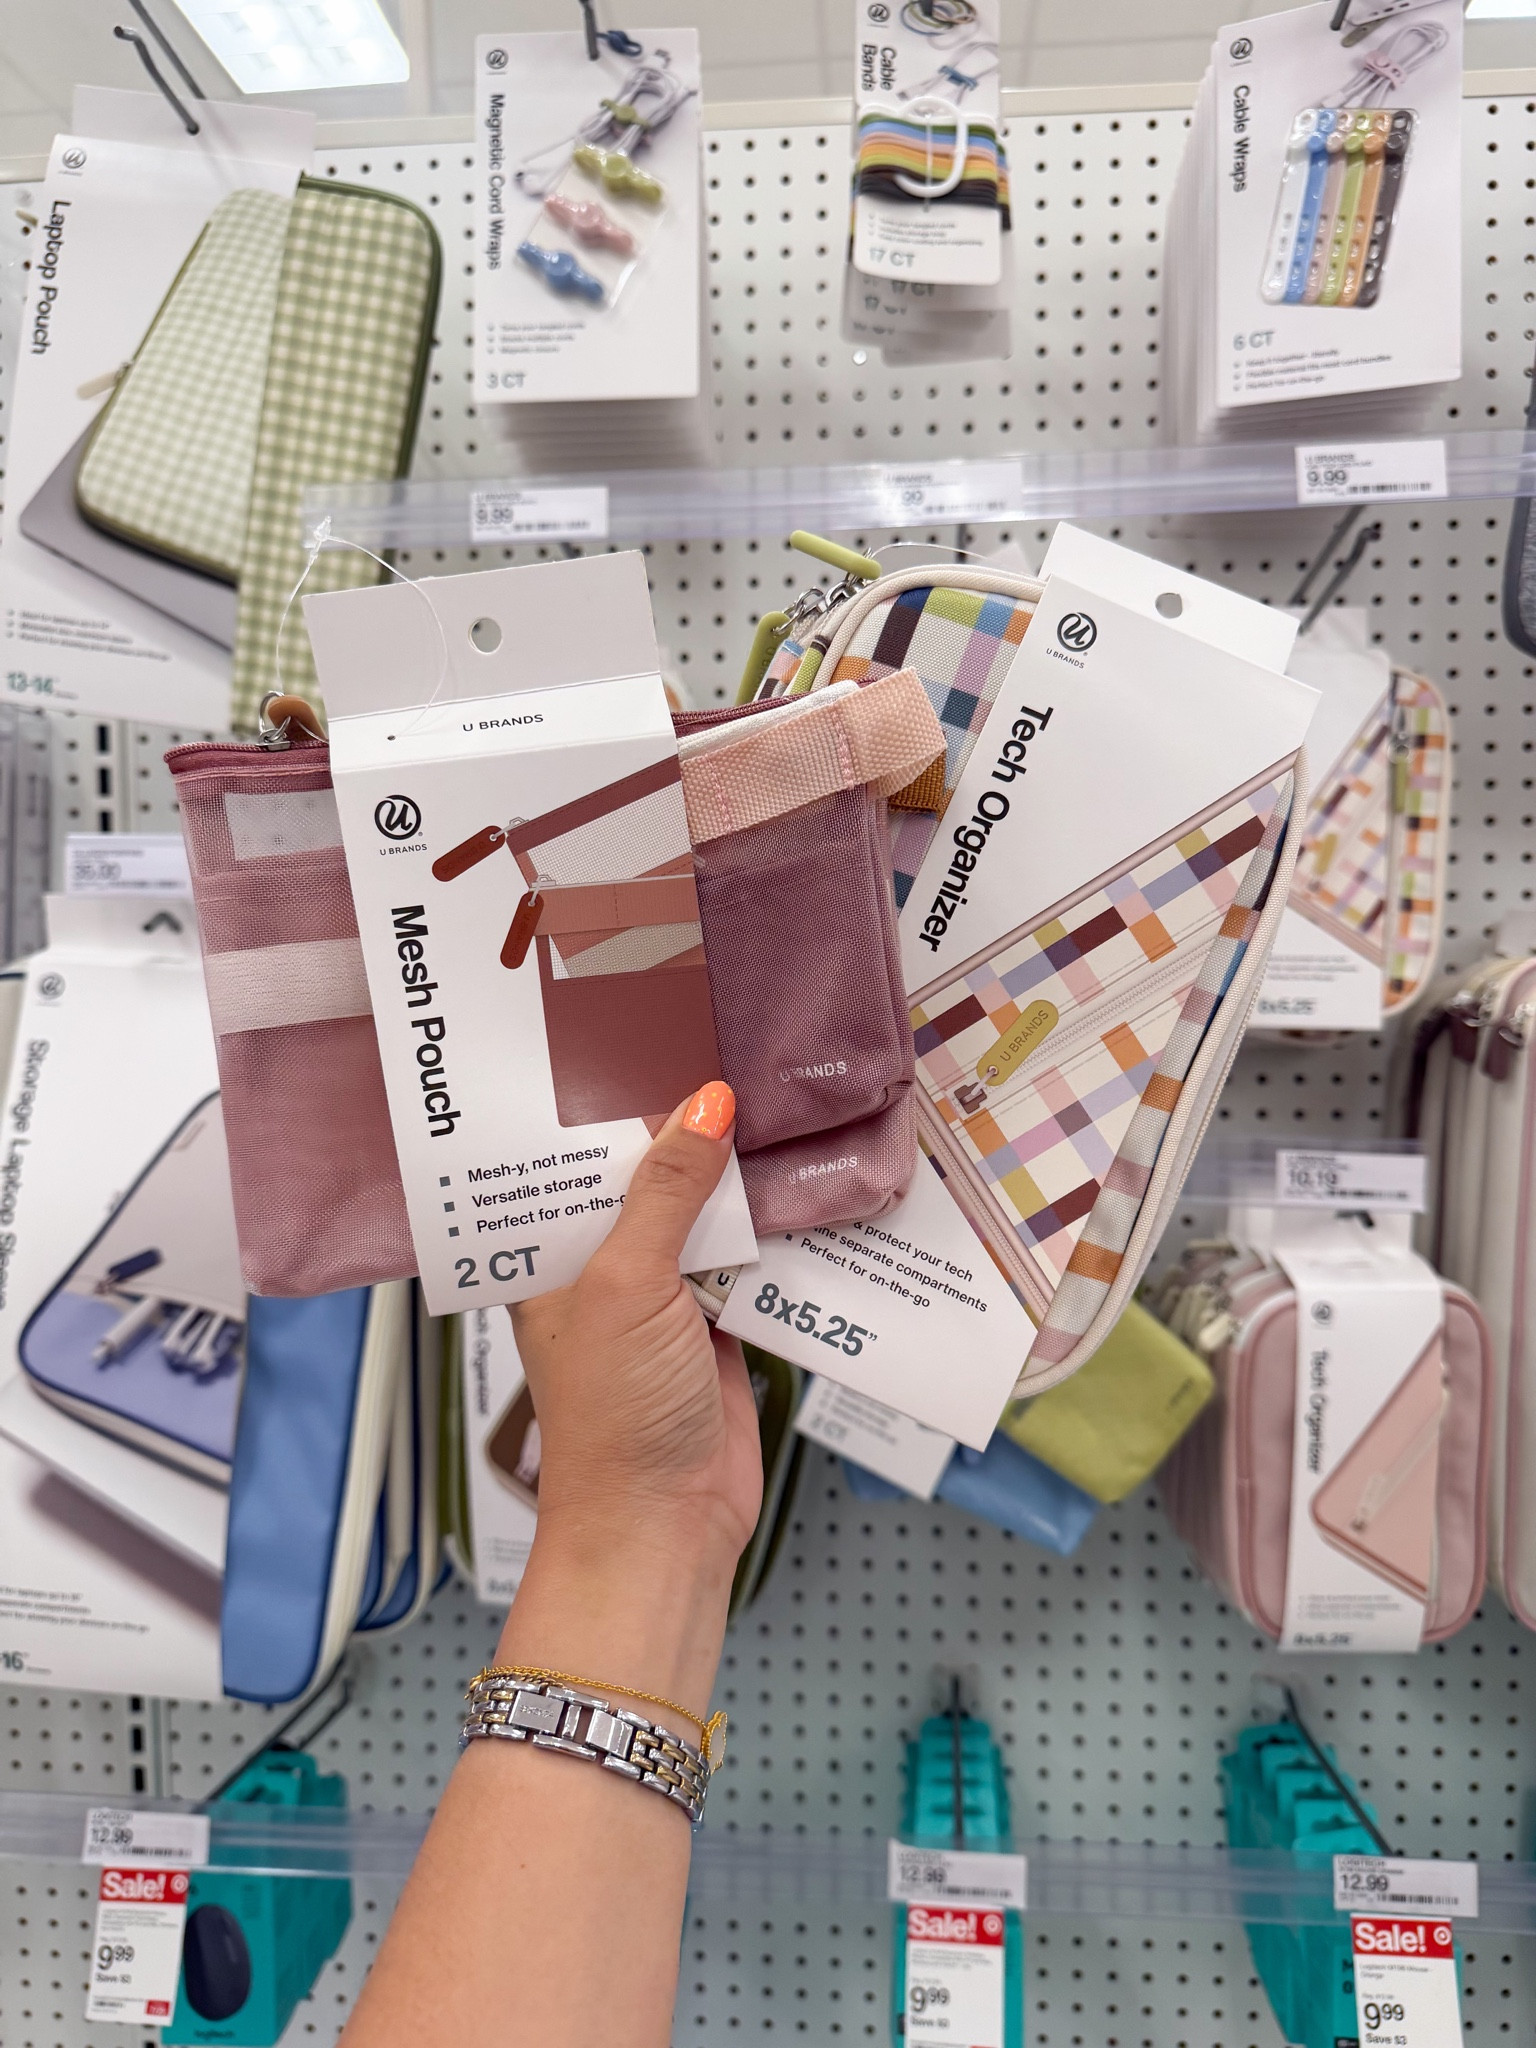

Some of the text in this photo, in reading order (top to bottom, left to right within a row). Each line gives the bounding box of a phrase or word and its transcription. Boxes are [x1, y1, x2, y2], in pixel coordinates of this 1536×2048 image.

[862, 44, 878, 91] Bands
[880, 47, 897, 91] Cable
[1229, 85, 1251, 193] Cable Wraps
[485, 94, 505, 271] Magnetic Cord Wraps
[31, 200, 72, 354] Laptop Pouch
[1307, 470, 1346, 487] 9.99
[1053, 651, 1085, 669] BRANDS
[462, 714, 544, 732] U BRANDS
[919, 705, 1054, 952] Tech Organizer
[388, 844, 427, 855] BRANDS
[391, 905, 462, 1137] Mesh Pouch
[1000, 1010, 1049, 1062] U BRANDS
[792, 1061, 847, 1079] RANDS
[467, 1145, 609, 1183] Mesh-y, not messy
[472, 1174, 602, 1208] Versatile storage
[476, 1210, 535, 1234] Perfect
[539, 1206, 560, 1222] for
[454, 1245, 541, 1289] 2 CT
[864, 1225, 912, 1253] protect
[913, 1248, 943, 1267] your
[944, 1261, 973, 1282] tech
[800, 1237, 931, 1308] Perfect for on-the-go
[839, 1235, 894, 1267] separate
[896, 1263, 988, 1313] compartments
[91, 1827, 134, 1846] 12.99
[102, 1871, 166, 1901] Sale!
[1341, 1874, 1389, 1891] 12.99
[908, 1908, 978, 1941] Sale!
[1355, 1921, 1427, 1953] Sale!
[1365, 2033, 1392, 2045] Save
